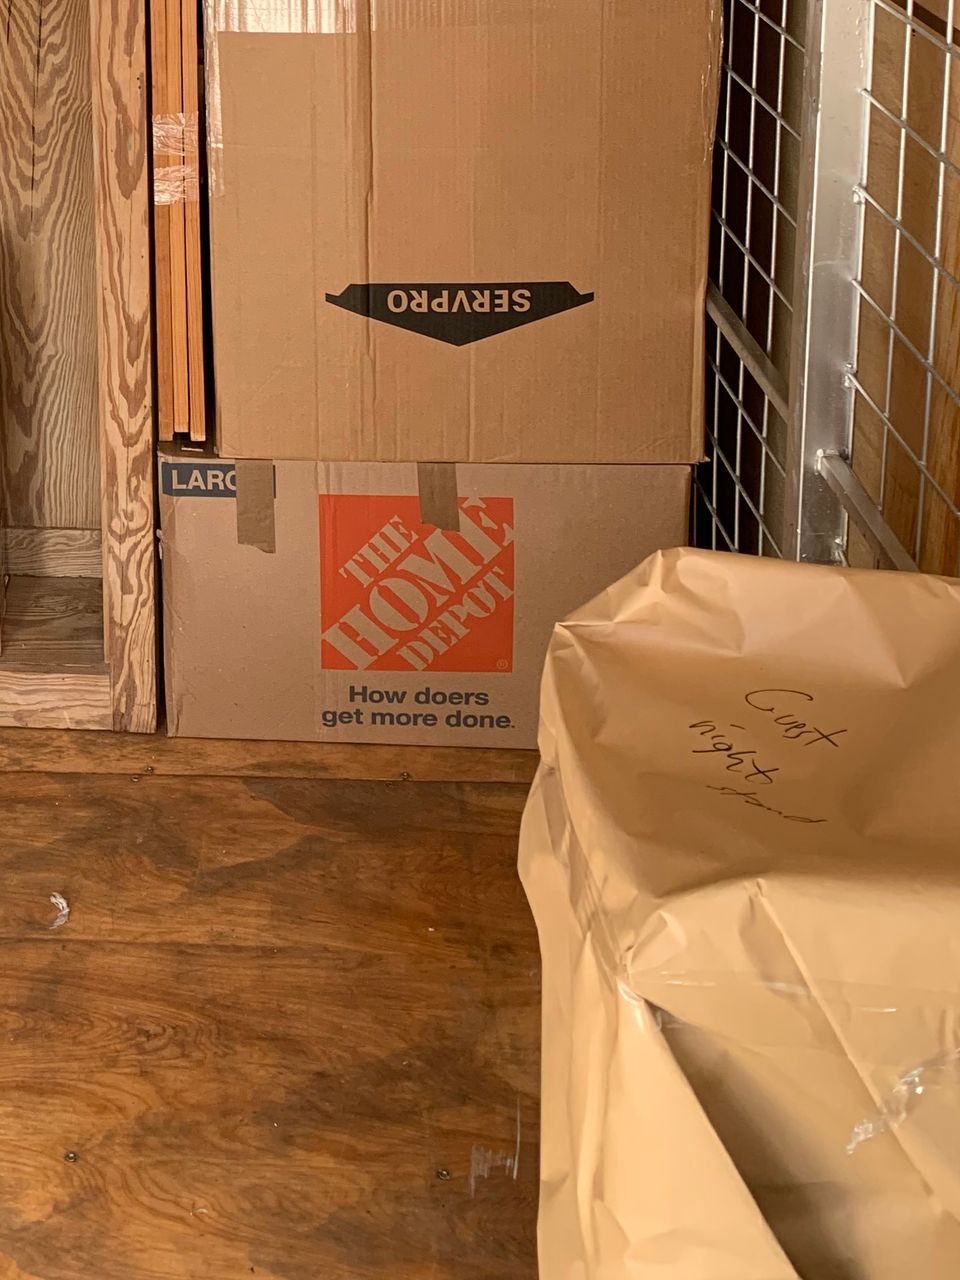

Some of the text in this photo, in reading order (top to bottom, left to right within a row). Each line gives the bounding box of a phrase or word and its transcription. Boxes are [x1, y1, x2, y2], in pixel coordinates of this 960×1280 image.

[387, 288, 532, 314] SERVPRO
[171, 469, 237, 491] LAR
[338, 515, 419, 588] THE
[321, 496, 515, 671] HOME
[396, 566, 514, 672] DEPOT
[348, 685, 489, 706] How doers
[322, 708, 364, 728] get
[371, 711, 438, 727] more
